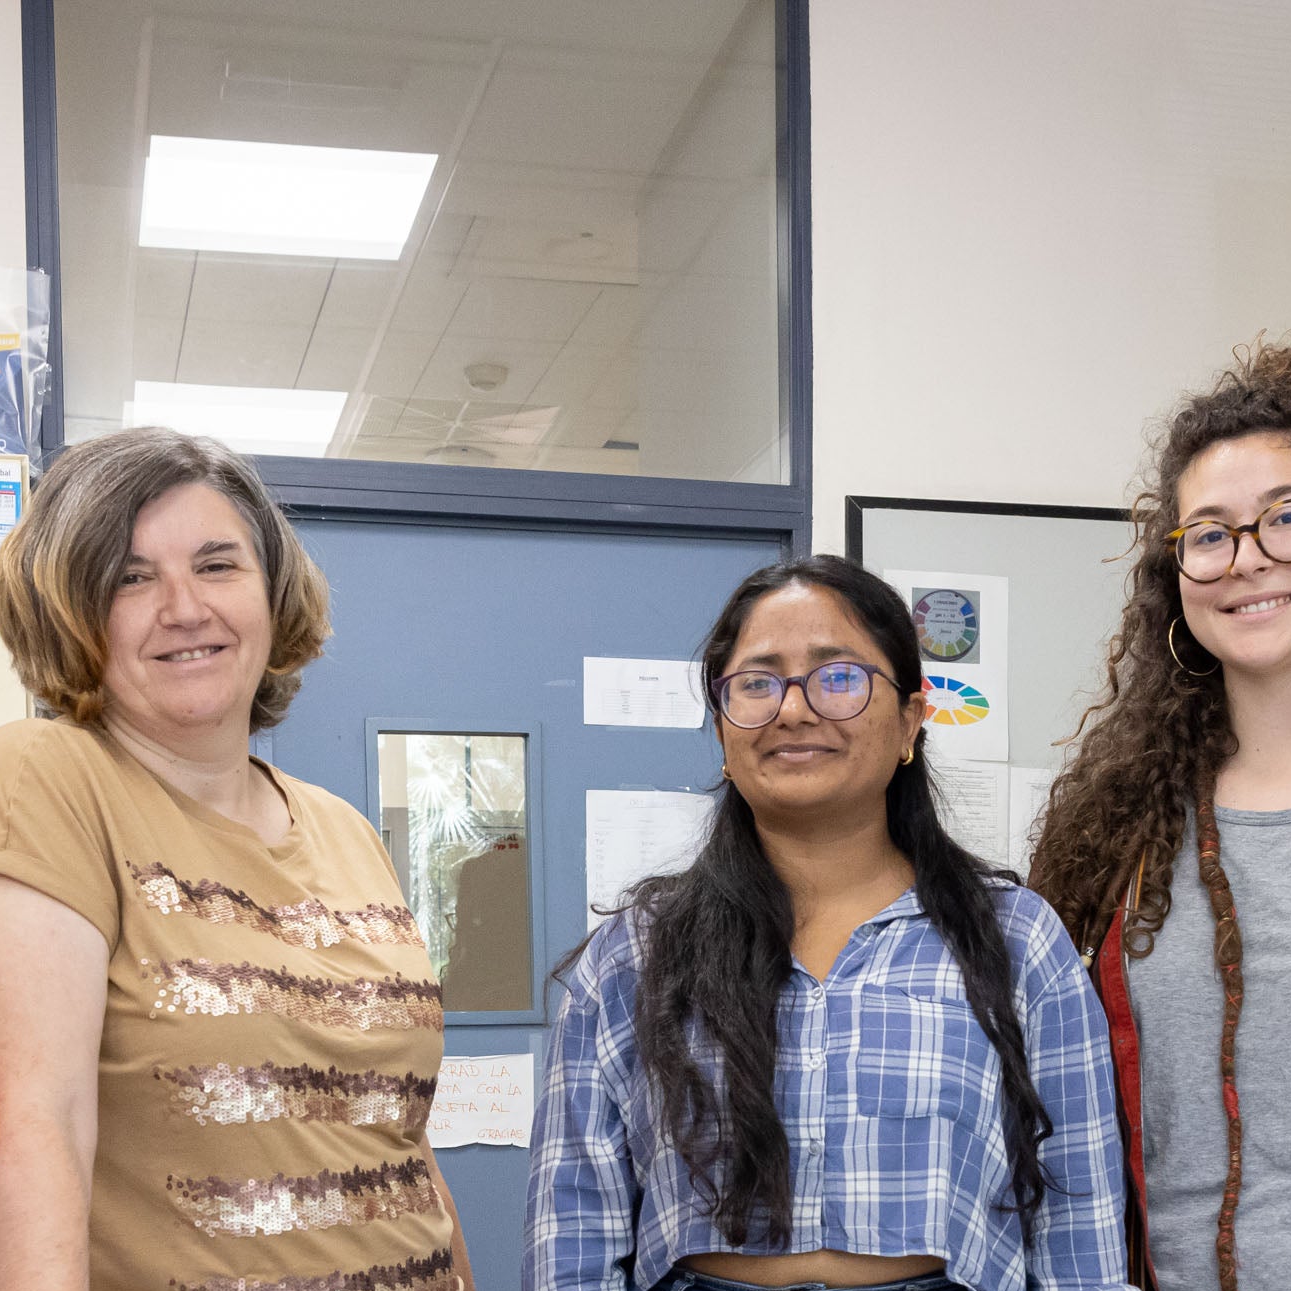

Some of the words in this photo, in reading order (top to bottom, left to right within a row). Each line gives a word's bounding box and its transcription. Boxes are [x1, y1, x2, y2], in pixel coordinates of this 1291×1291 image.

[439, 1064, 480, 1077] RRAD
[490, 1065, 510, 1077] LA
[436, 1083, 462, 1095] RTA
[507, 1083, 522, 1096] LA
[430, 1102, 479, 1113] ARJETA
[490, 1101, 511, 1113] AL
[427, 1119, 453, 1131] ALIR
[477, 1128, 526, 1140] GRACIAS
